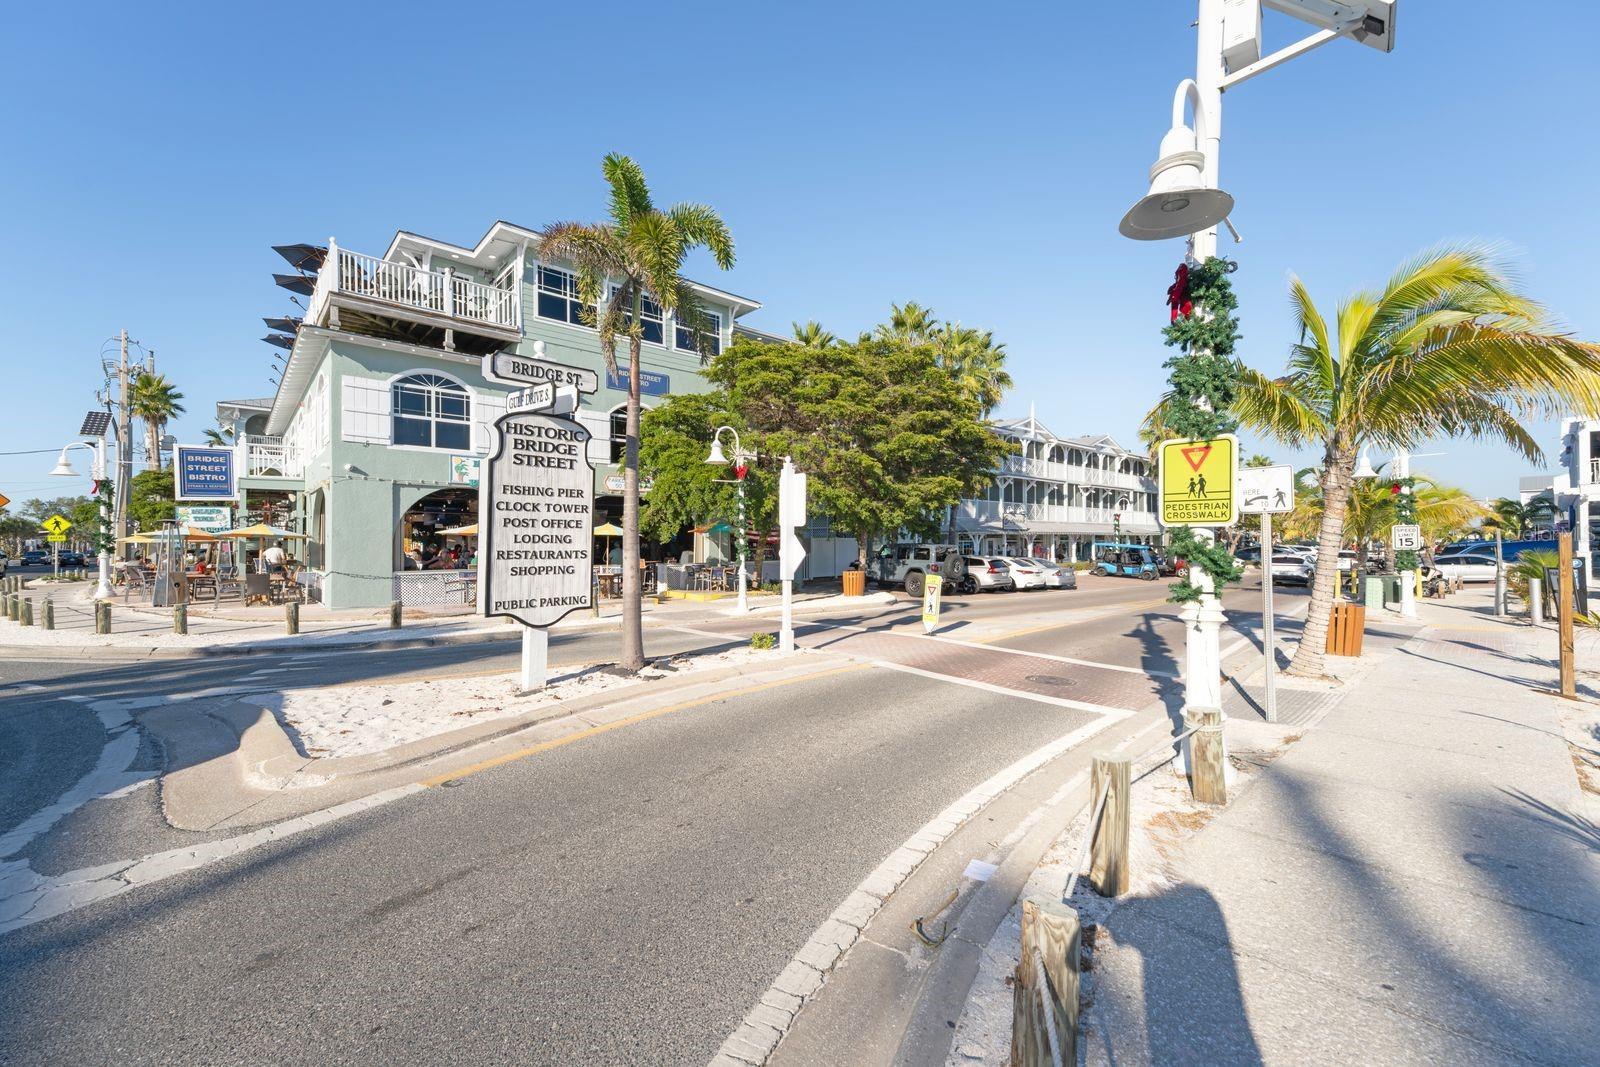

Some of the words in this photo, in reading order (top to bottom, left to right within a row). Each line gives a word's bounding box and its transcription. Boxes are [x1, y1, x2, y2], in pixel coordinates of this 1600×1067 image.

[511, 361, 563, 382] BRIDGE
[566, 372, 583, 387] ST.
[639, 374, 661, 383] STREET
[508, 394, 525, 409] GULF
[525, 390, 543, 406] DRIVE
[505, 422, 584, 442] HISTORIC
[513, 438, 578, 456] BRIDGE
[187, 455, 226, 463] BRIDGE
[513, 453, 577, 470] STREET
[187, 464, 227, 472] STREET
[502, 484, 554, 497] FISHING
[557, 488, 584, 499] PIER
[1242, 488, 1261, 496] HERE
[496, 501, 541, 512] CLOCK
[545, 503, 589, 513] TOWER
[1165, 502, 1229, 511] PEDESTRIAN
[1166, 511, 1228, 519] CROSSWALK
[503, 518, 537, 528] POST
[541, 519, 582, 529] OFFICE
[514, 534, 572, 544] LODGING
[1399, 537, 1414, 546] 15
[496, 550, 587, 560] RESTAURANTS
[510, 565, 575, 576] SHOPPING
[495, 598, 537, 611] PUBLIC
[540, 595, 587, 607] PARKING
